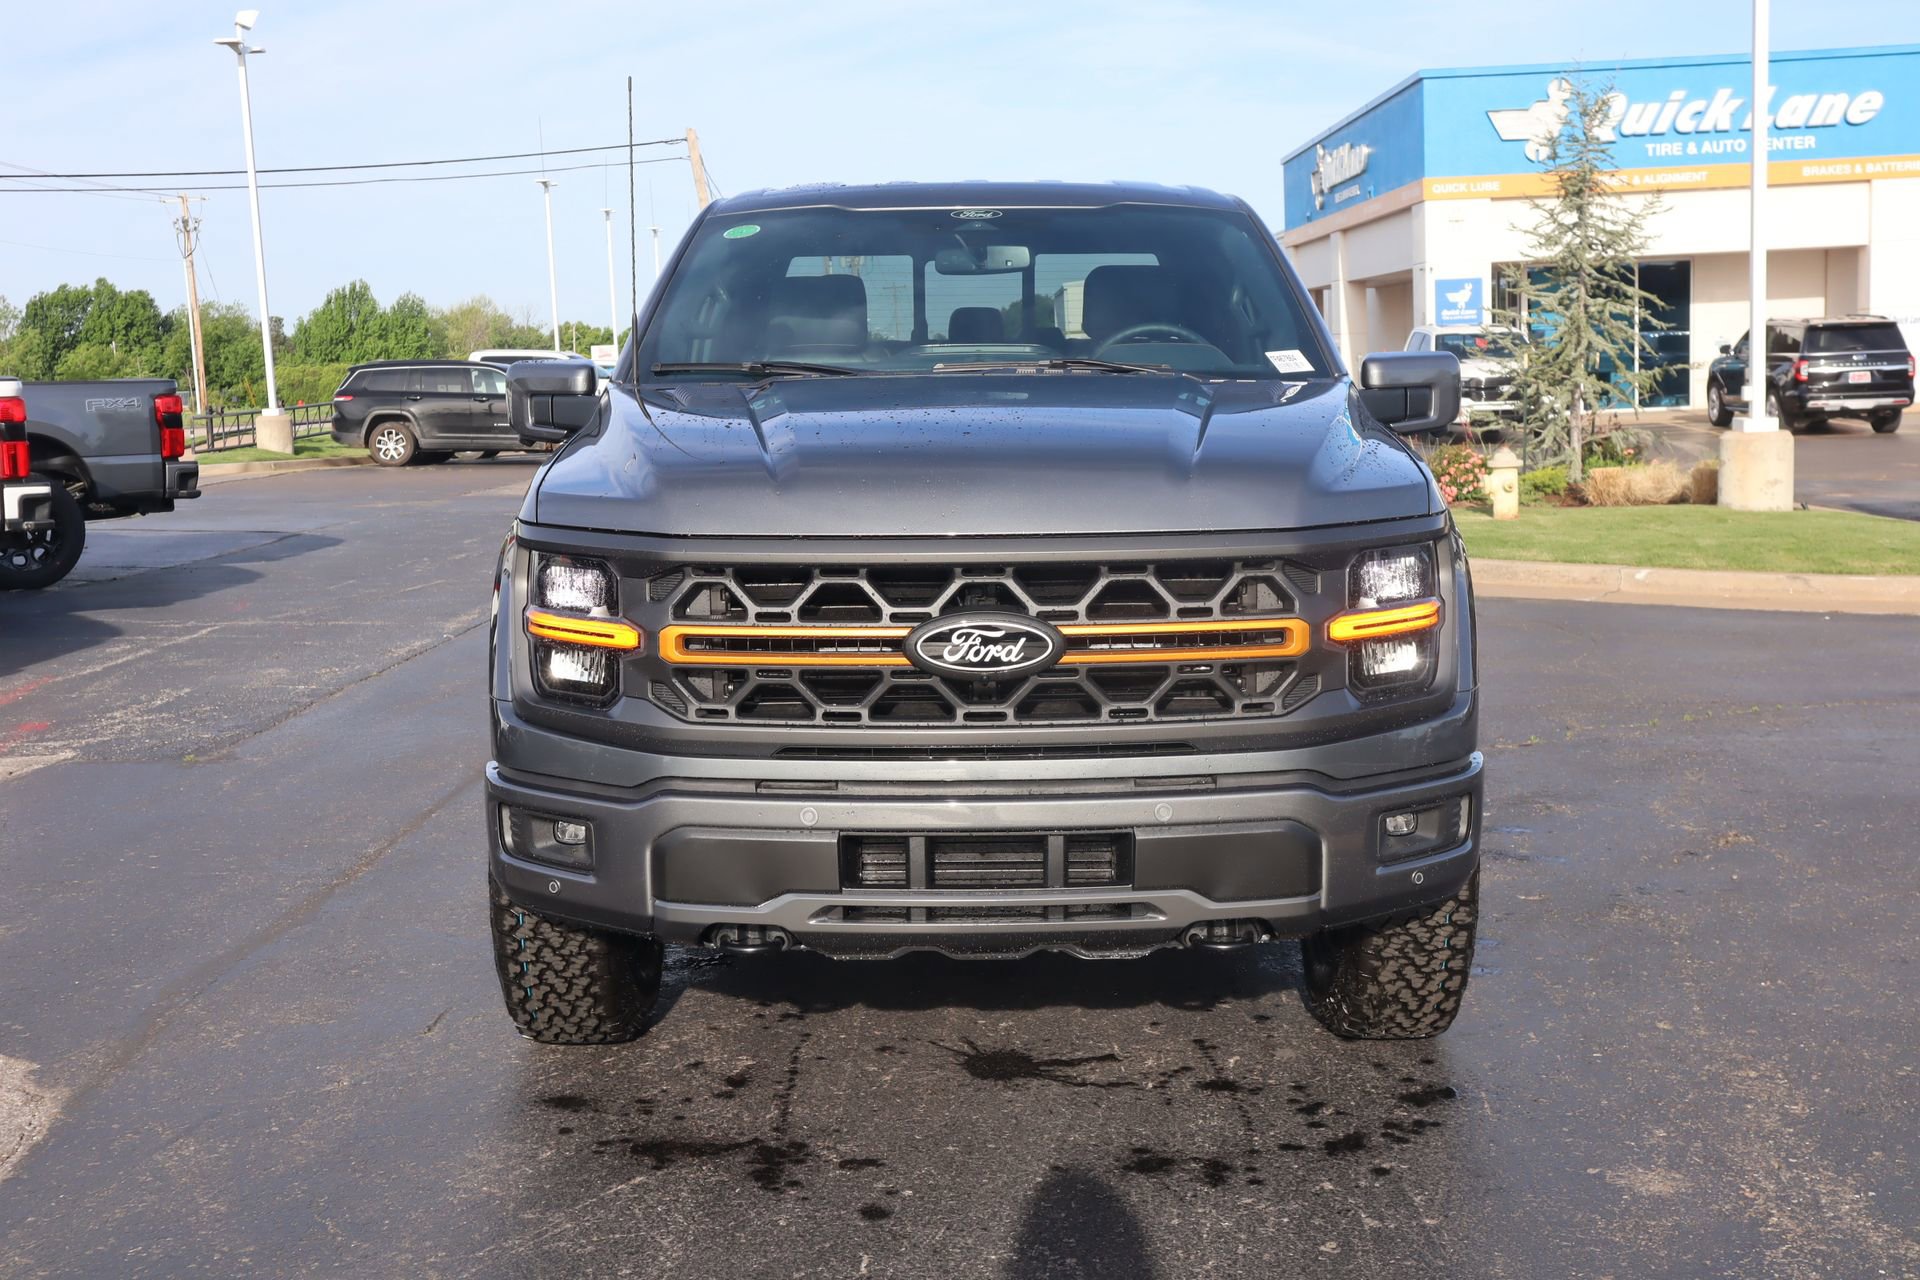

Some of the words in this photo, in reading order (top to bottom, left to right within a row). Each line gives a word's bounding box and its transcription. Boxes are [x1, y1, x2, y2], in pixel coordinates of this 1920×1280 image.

[1590, 87, 1745, 143] Quick
[1645, 143, 1683, 157] TIRE
[1686, 142, 1697, 155] &
[1702, 139, 1746, 154] AUTO
[1766, 135, 1816, 150] ENTER
[1643, 171, 1708, 184] ALIGNMENT
[1802, 164, 1851, 176] BRAKES
[1855, 163, 1862, 174] &
[1432, 183, 1468, 193] QUICK
[1470, 181, 1501, 192] LUBE
[85, 396, 142, 413] FX4
[943, 628, 1027, 663] Ford
